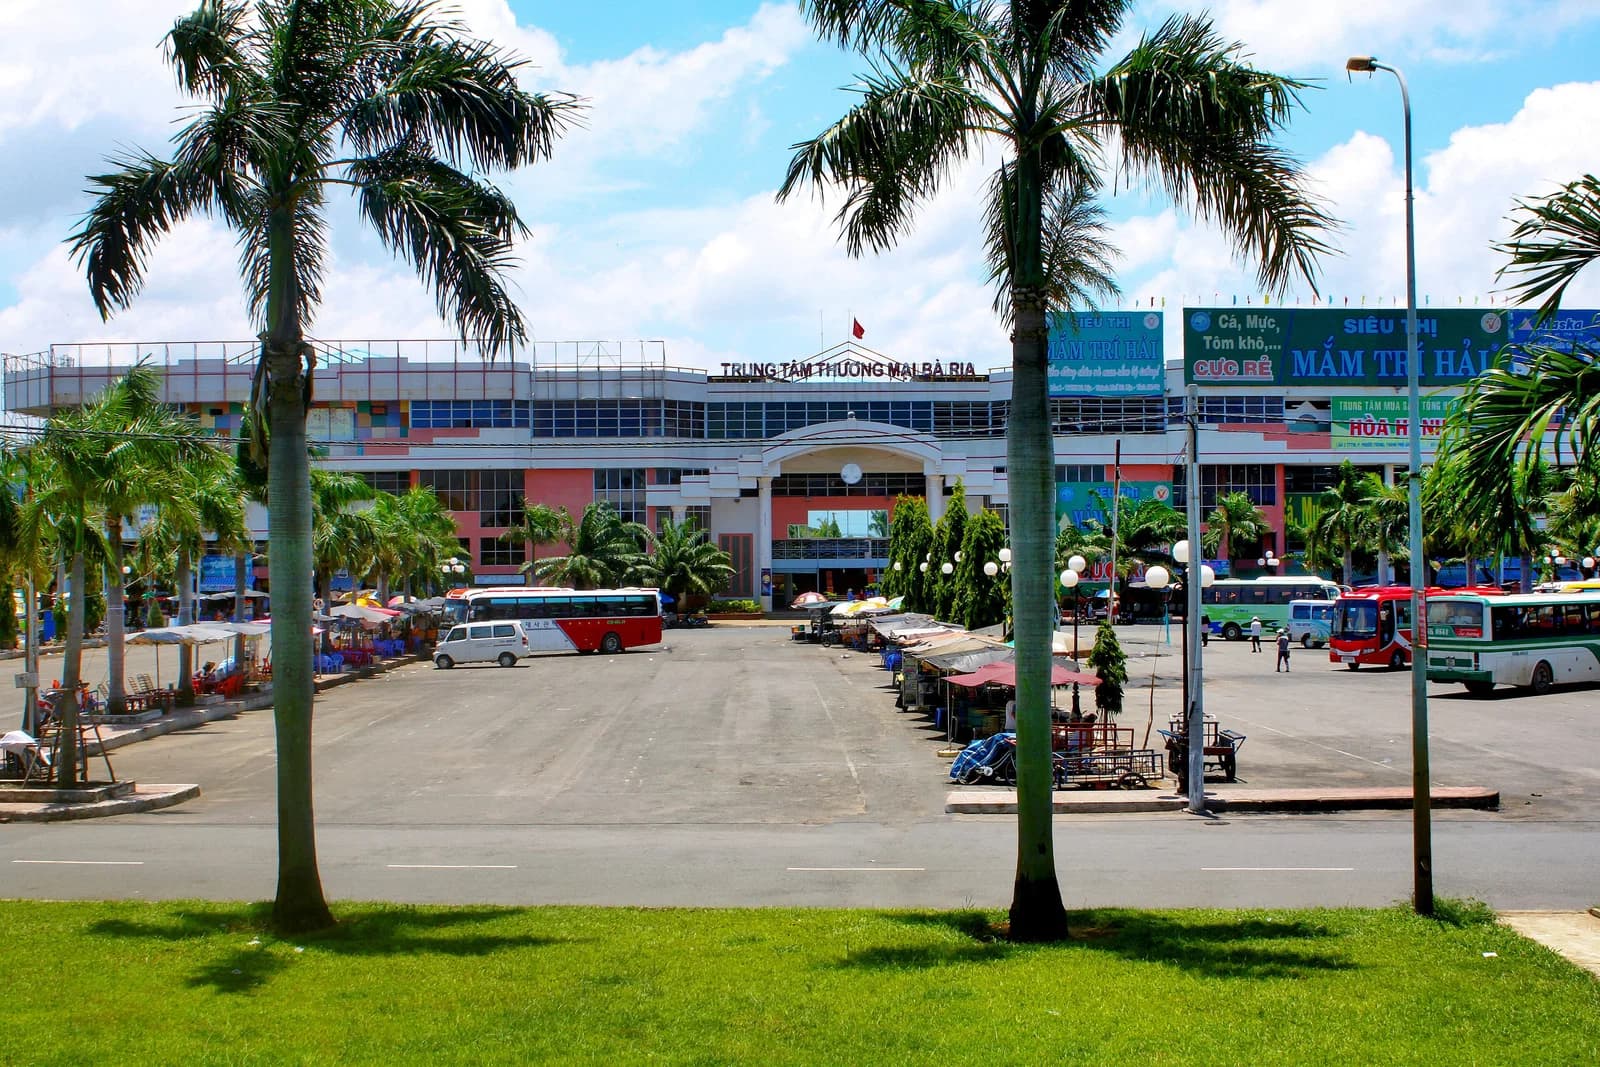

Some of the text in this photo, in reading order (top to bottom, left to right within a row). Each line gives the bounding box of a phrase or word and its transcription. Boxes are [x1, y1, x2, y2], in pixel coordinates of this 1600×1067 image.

[1218, 314, 1280, 333] Cá, Mực,
[1344, 315, 1394, 334] SIÊU
[1089, 336, 1121, 360] TRÍ
[1124, 335, 1158, 360] HẢI
[1203, 336, 1234, 350] Tôm
[1292, 335, 1365, 377] MẮM
[1433, 338, 1489, 377] HẢI
[721, 362, 777, 377] TRUNG
[779, 359, 812, 377] TÂM
[922, 358, 944, 376] BÀ
[1193, 355, 1273, 379] CỰC RẺ
[1339, 401, 1363, 411] TRUNG
[1365, 400, 1382, 411] TÂM
[1383, 401, 1401, 411] MUA
[1349, 413, 1389, 436] HÒA
